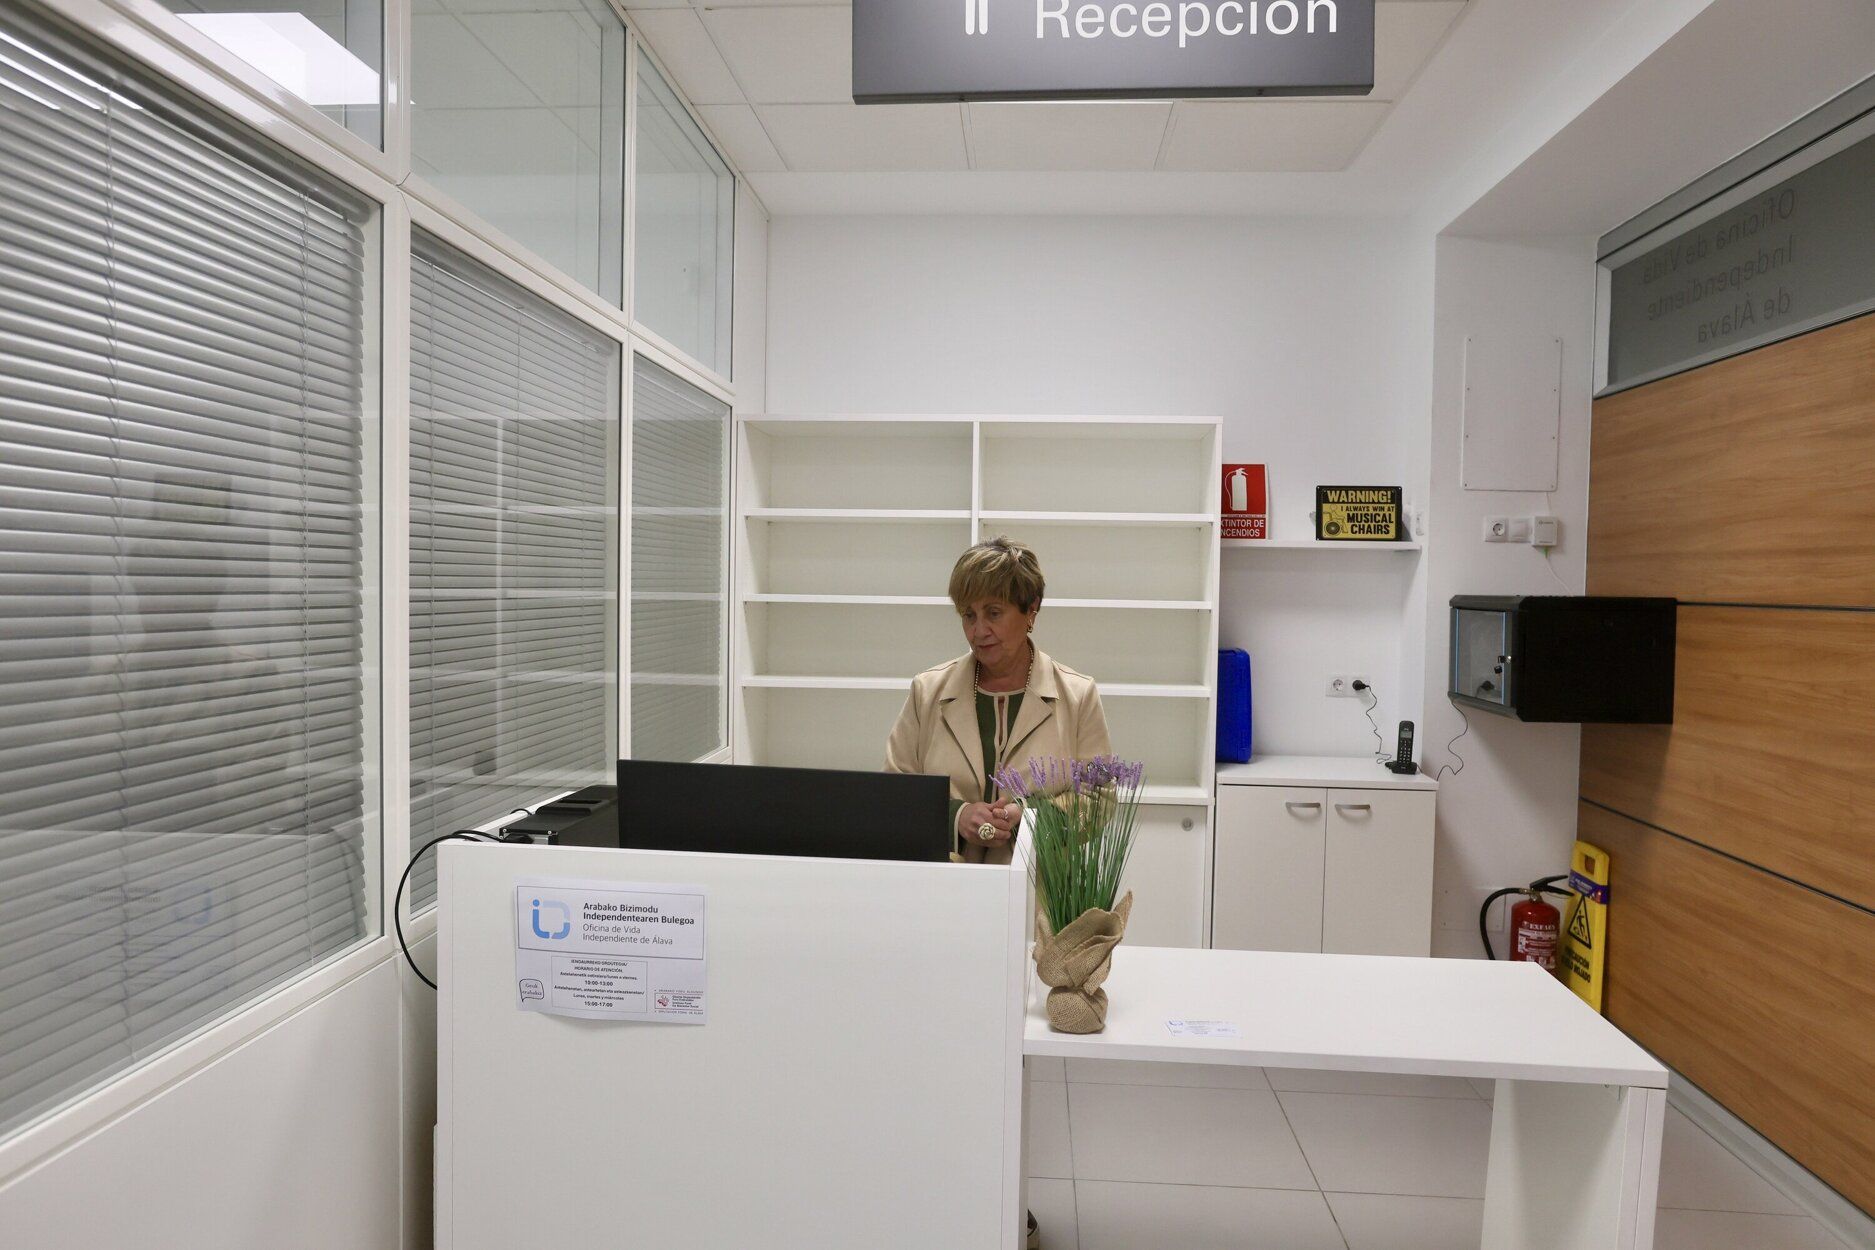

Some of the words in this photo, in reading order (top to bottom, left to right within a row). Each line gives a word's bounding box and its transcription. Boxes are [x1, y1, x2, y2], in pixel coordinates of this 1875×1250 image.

[1326, 490, 1392, 503] WARNING!
[1221, 519, 1251, 528] XTINTOR
[1253, 519, 1264, 528] DE
[1346, 513, 1394, 523] MUSICAL
[1221, 528, 1260, 537] NCENDIOS
[1350, 524, 1390, 534] CHAIRS
[583, 902, 618, 912] Arabako
[619, 904, 659, 914] Bizimodu
[583, 912, 659, 923] Independentearen
[661, 915, 695, 926] Bulegoa
[582, 923, 610, 933] Oficina
[611, 925, 622, 933] de
[623, 925, 641, 934] Vida
[582, 933, 638, 944] Independiente
[640, 936, 650, 944] de
